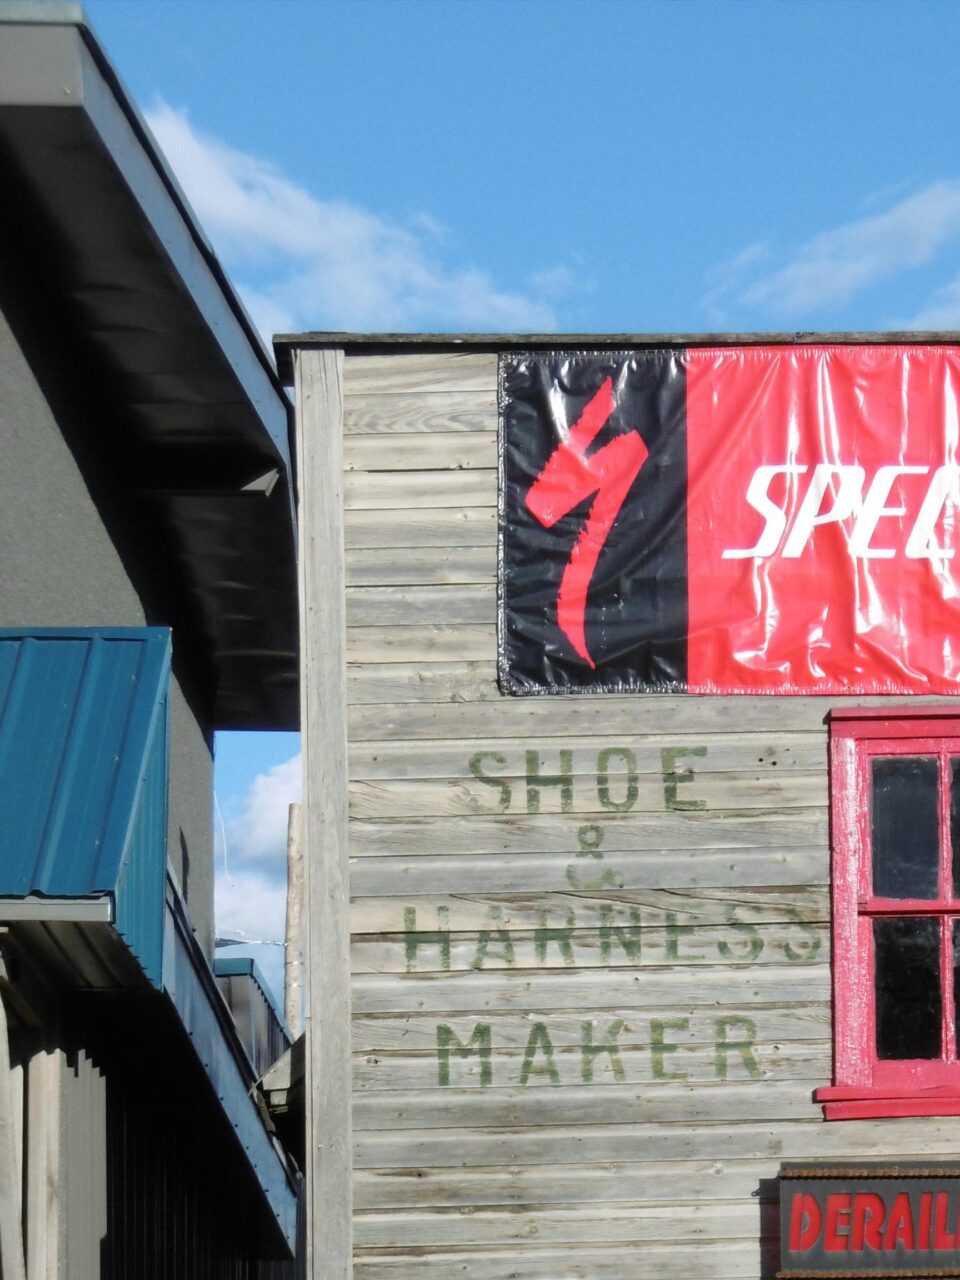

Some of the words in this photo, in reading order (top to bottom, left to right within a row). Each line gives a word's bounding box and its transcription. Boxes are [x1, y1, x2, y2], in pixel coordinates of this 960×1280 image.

[469, 746, 708, 813] SHOE
[566, 825, 624, 890] &
[403, 904, 822, 972] HARNESS
[436, 1014, 766, 1087] MAKER
